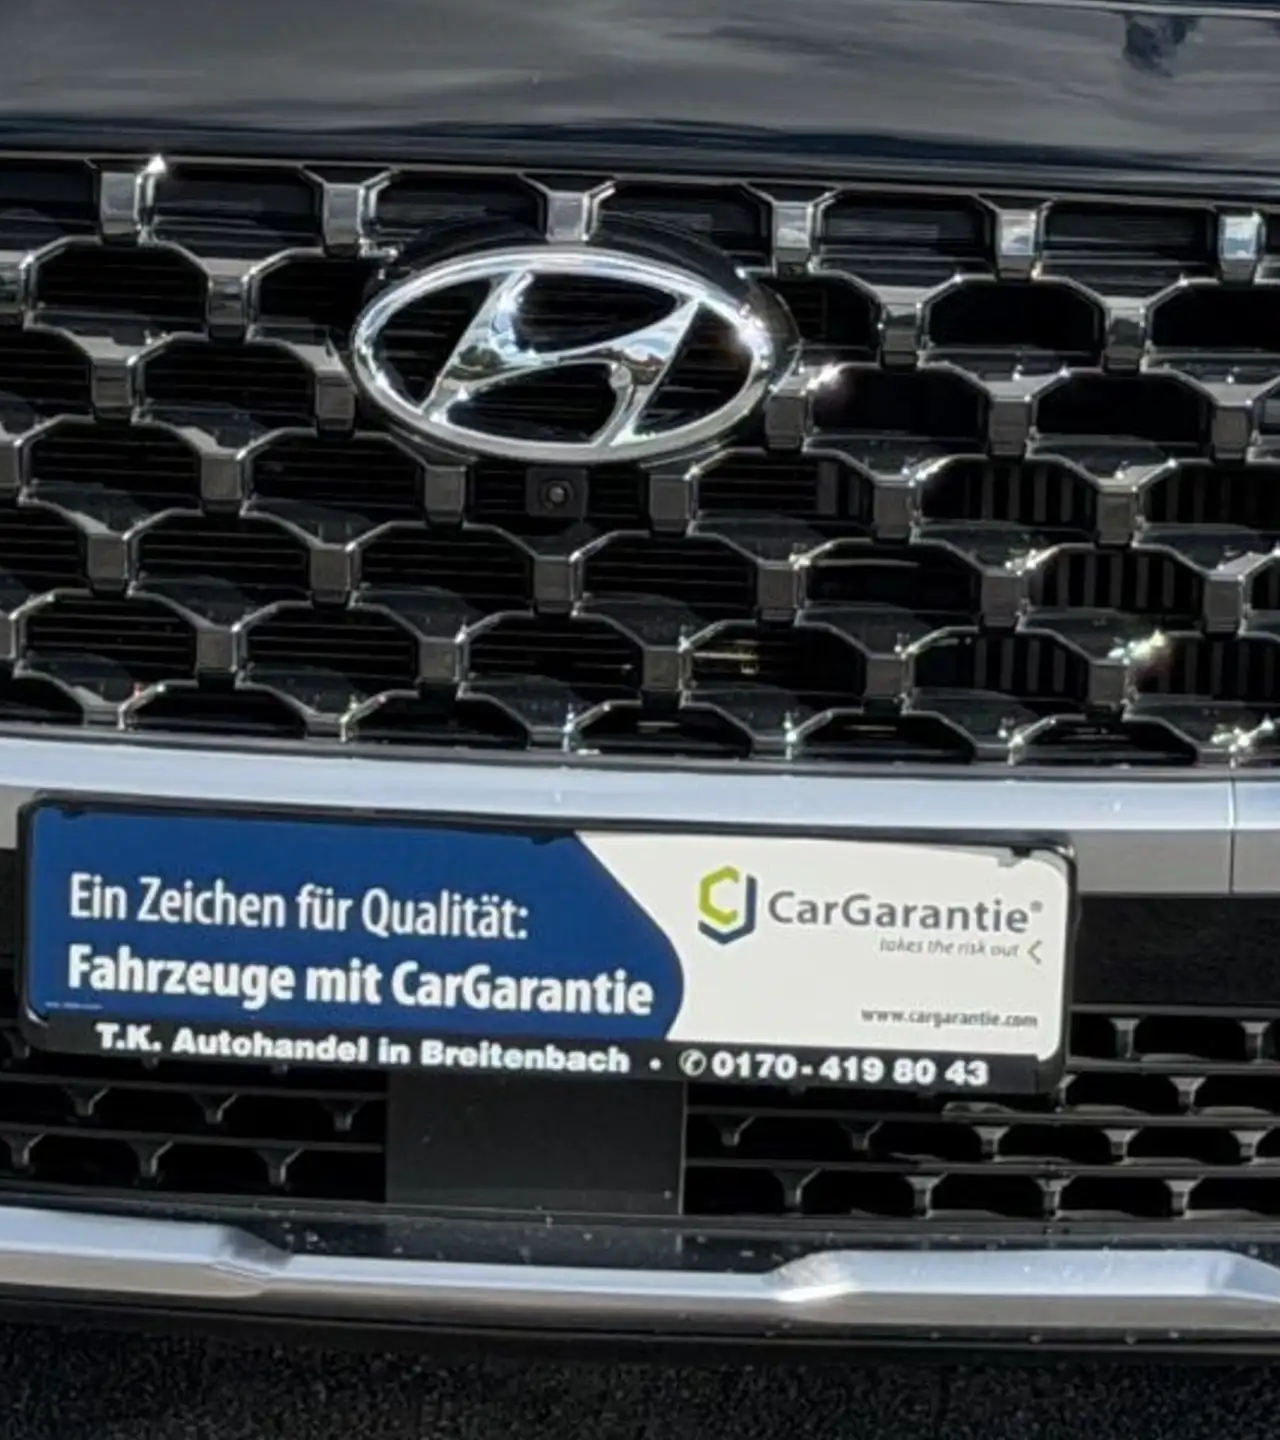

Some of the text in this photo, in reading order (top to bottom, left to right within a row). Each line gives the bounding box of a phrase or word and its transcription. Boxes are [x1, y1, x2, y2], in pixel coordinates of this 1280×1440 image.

[69, 872, 530, 939] Ein Zeichen für Qualität:
[68, 944, 655, 1015] Fahrzeuge mit CarGarantie
[927, 938, 955, 955] the
[957, 940, 987, 956] risk
[991, 943, 1019, 957] out
[860, 1009, 1038, 1029] www.cargarantie.com
[95, 1022, 162, 1052] T.K.
[171, 1027, 368, 1062] Autohandel
[378, 1037, 411, 1064] in
[420, 1038, 630, 1073] Breitenbach
[892, 1058, 936, 1084] 80
[944, 1060, 989, 1086] 43
